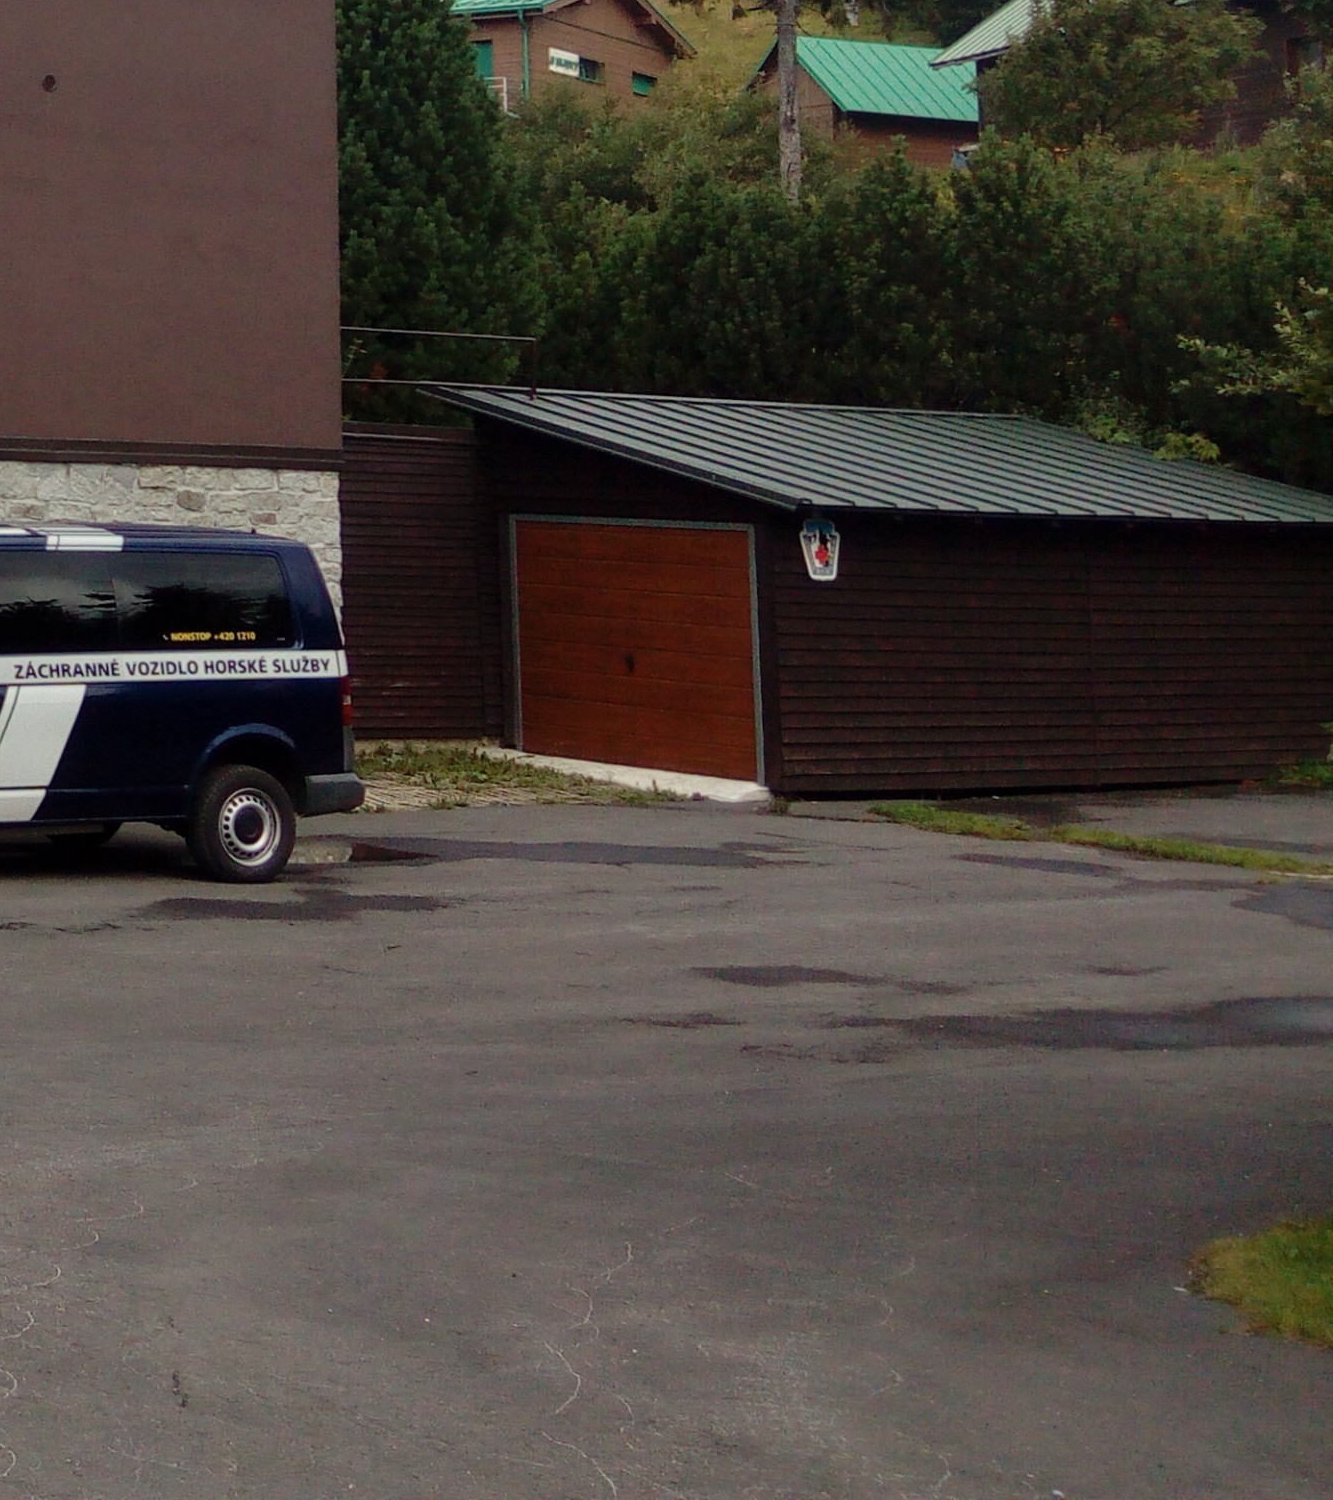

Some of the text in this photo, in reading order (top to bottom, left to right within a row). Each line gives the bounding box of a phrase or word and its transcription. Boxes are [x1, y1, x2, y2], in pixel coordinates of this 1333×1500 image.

[170, 631, 256, 641] NONSTOP +420 1210
[14, 656, 330, 680] ZÁCHRANNÉ VOZIDLO HORSKÉ SLUŽBY
